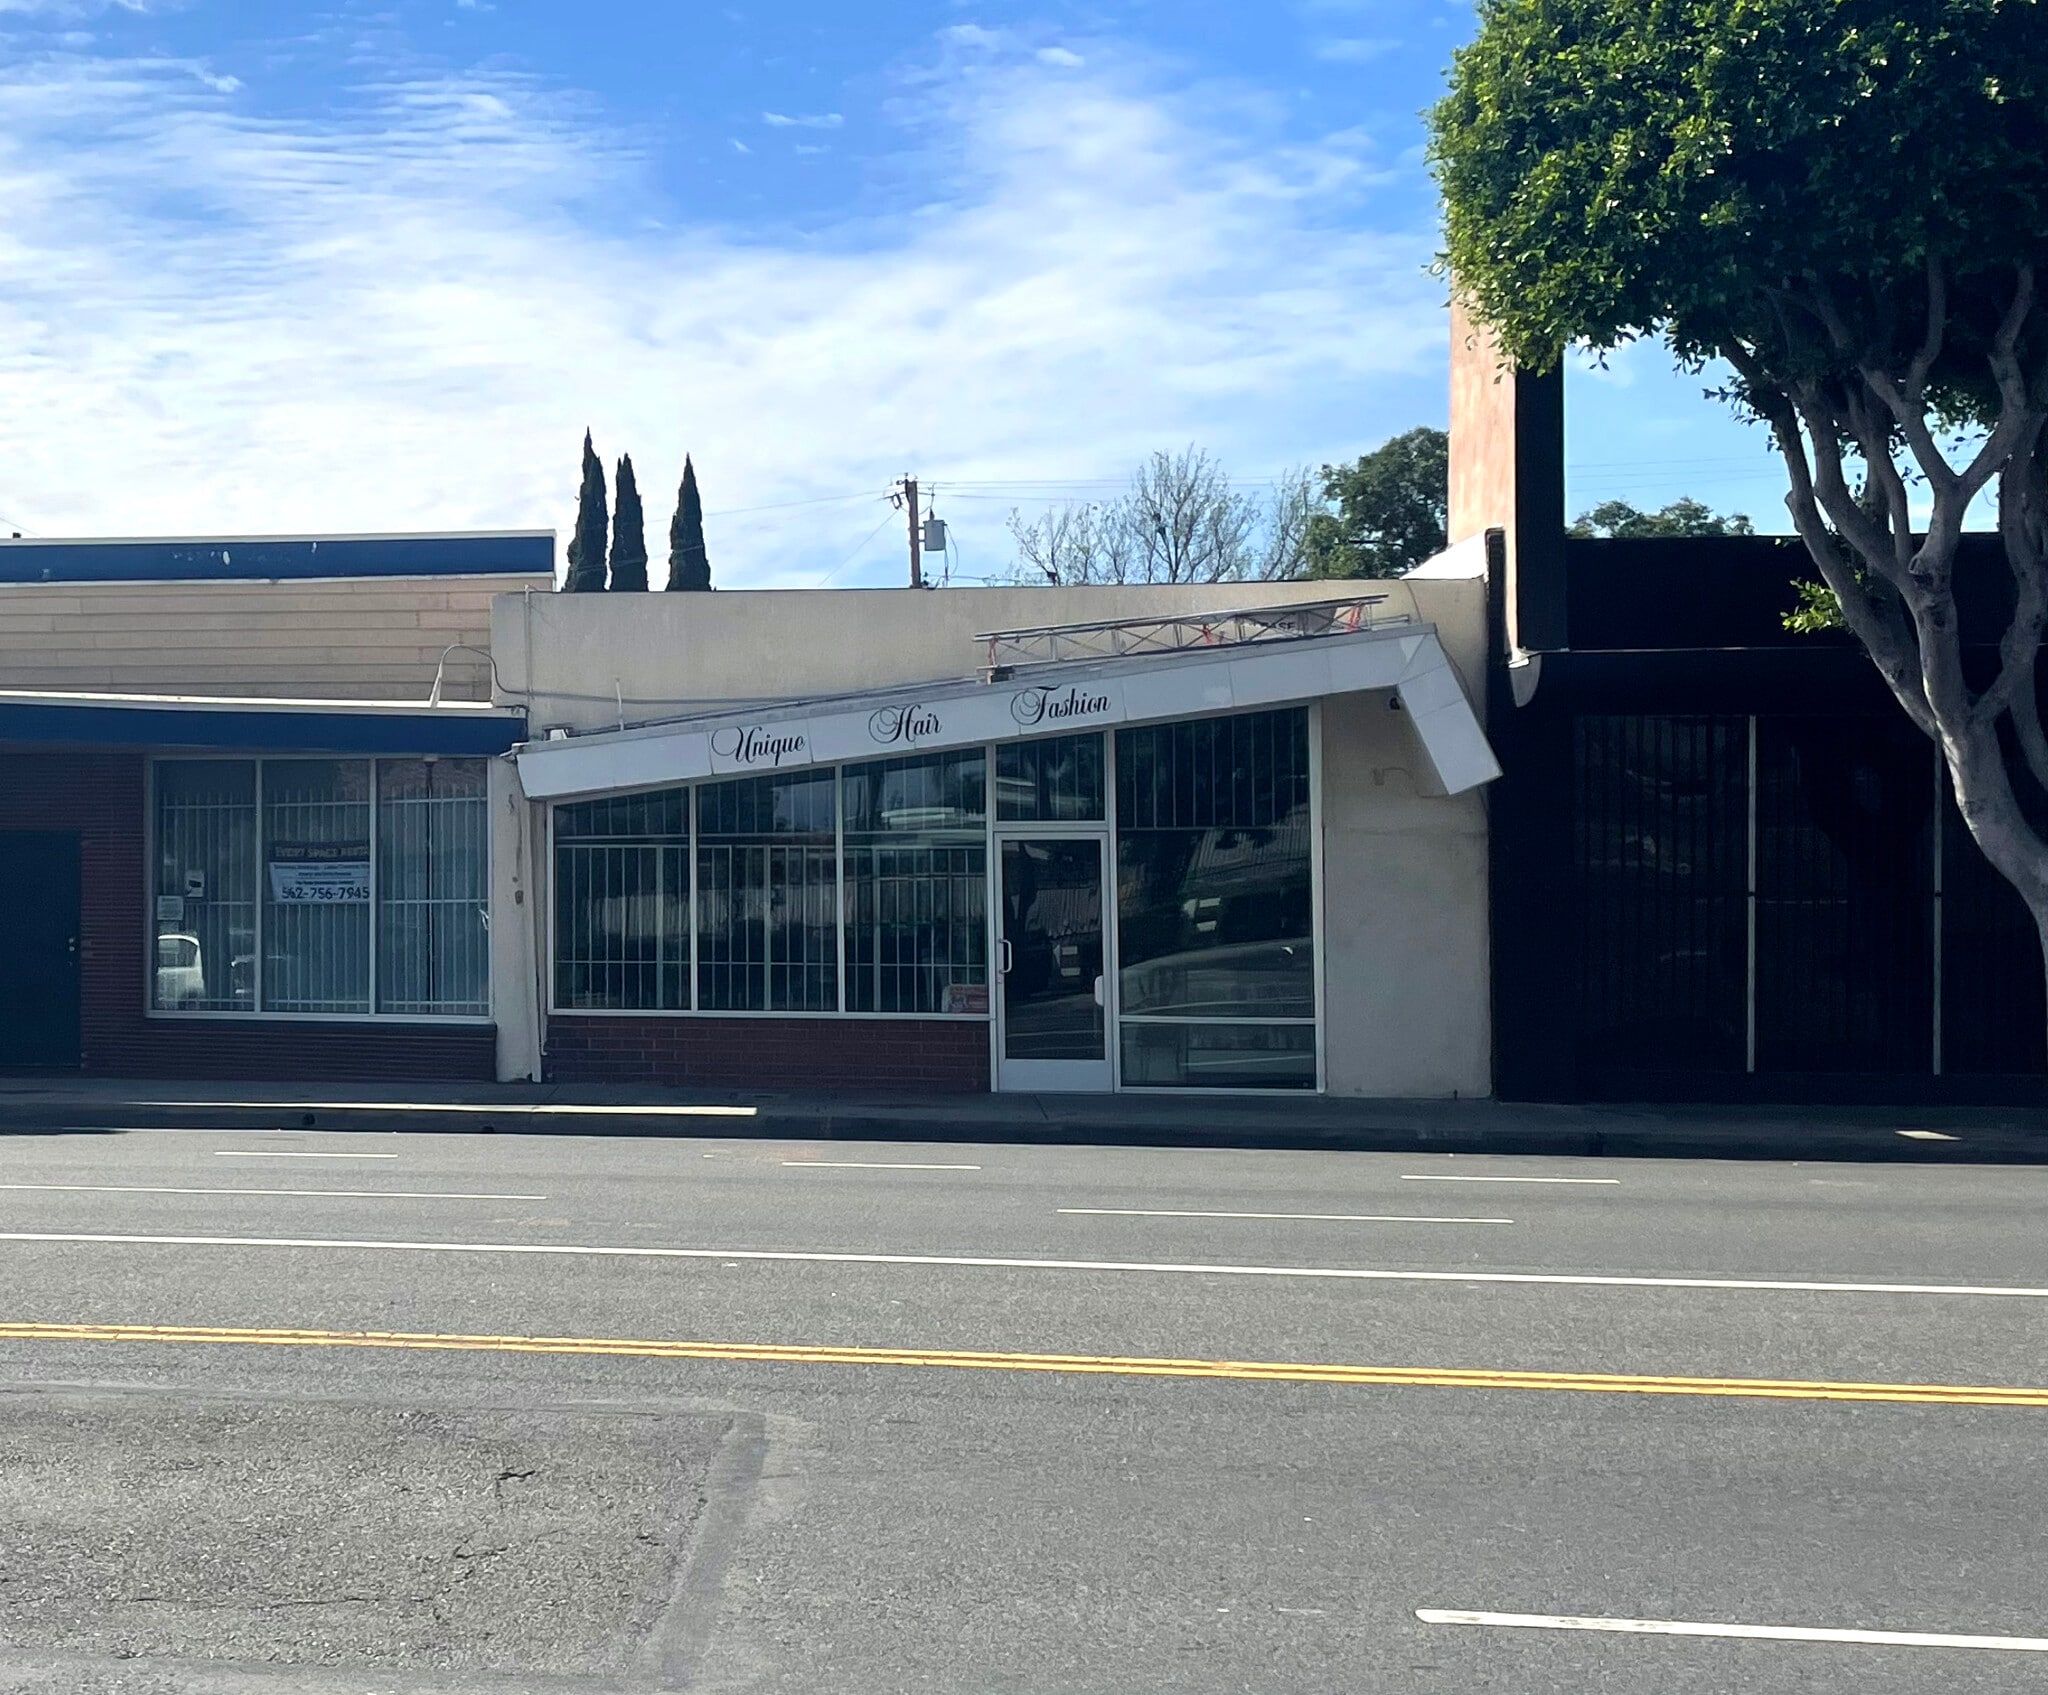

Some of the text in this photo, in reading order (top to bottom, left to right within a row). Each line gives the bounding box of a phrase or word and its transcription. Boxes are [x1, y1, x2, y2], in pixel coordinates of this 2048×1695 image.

[711, 683, 1111, 766] Unique Hair Fashion
[281, 887, 370, 900] 562-756-7945
